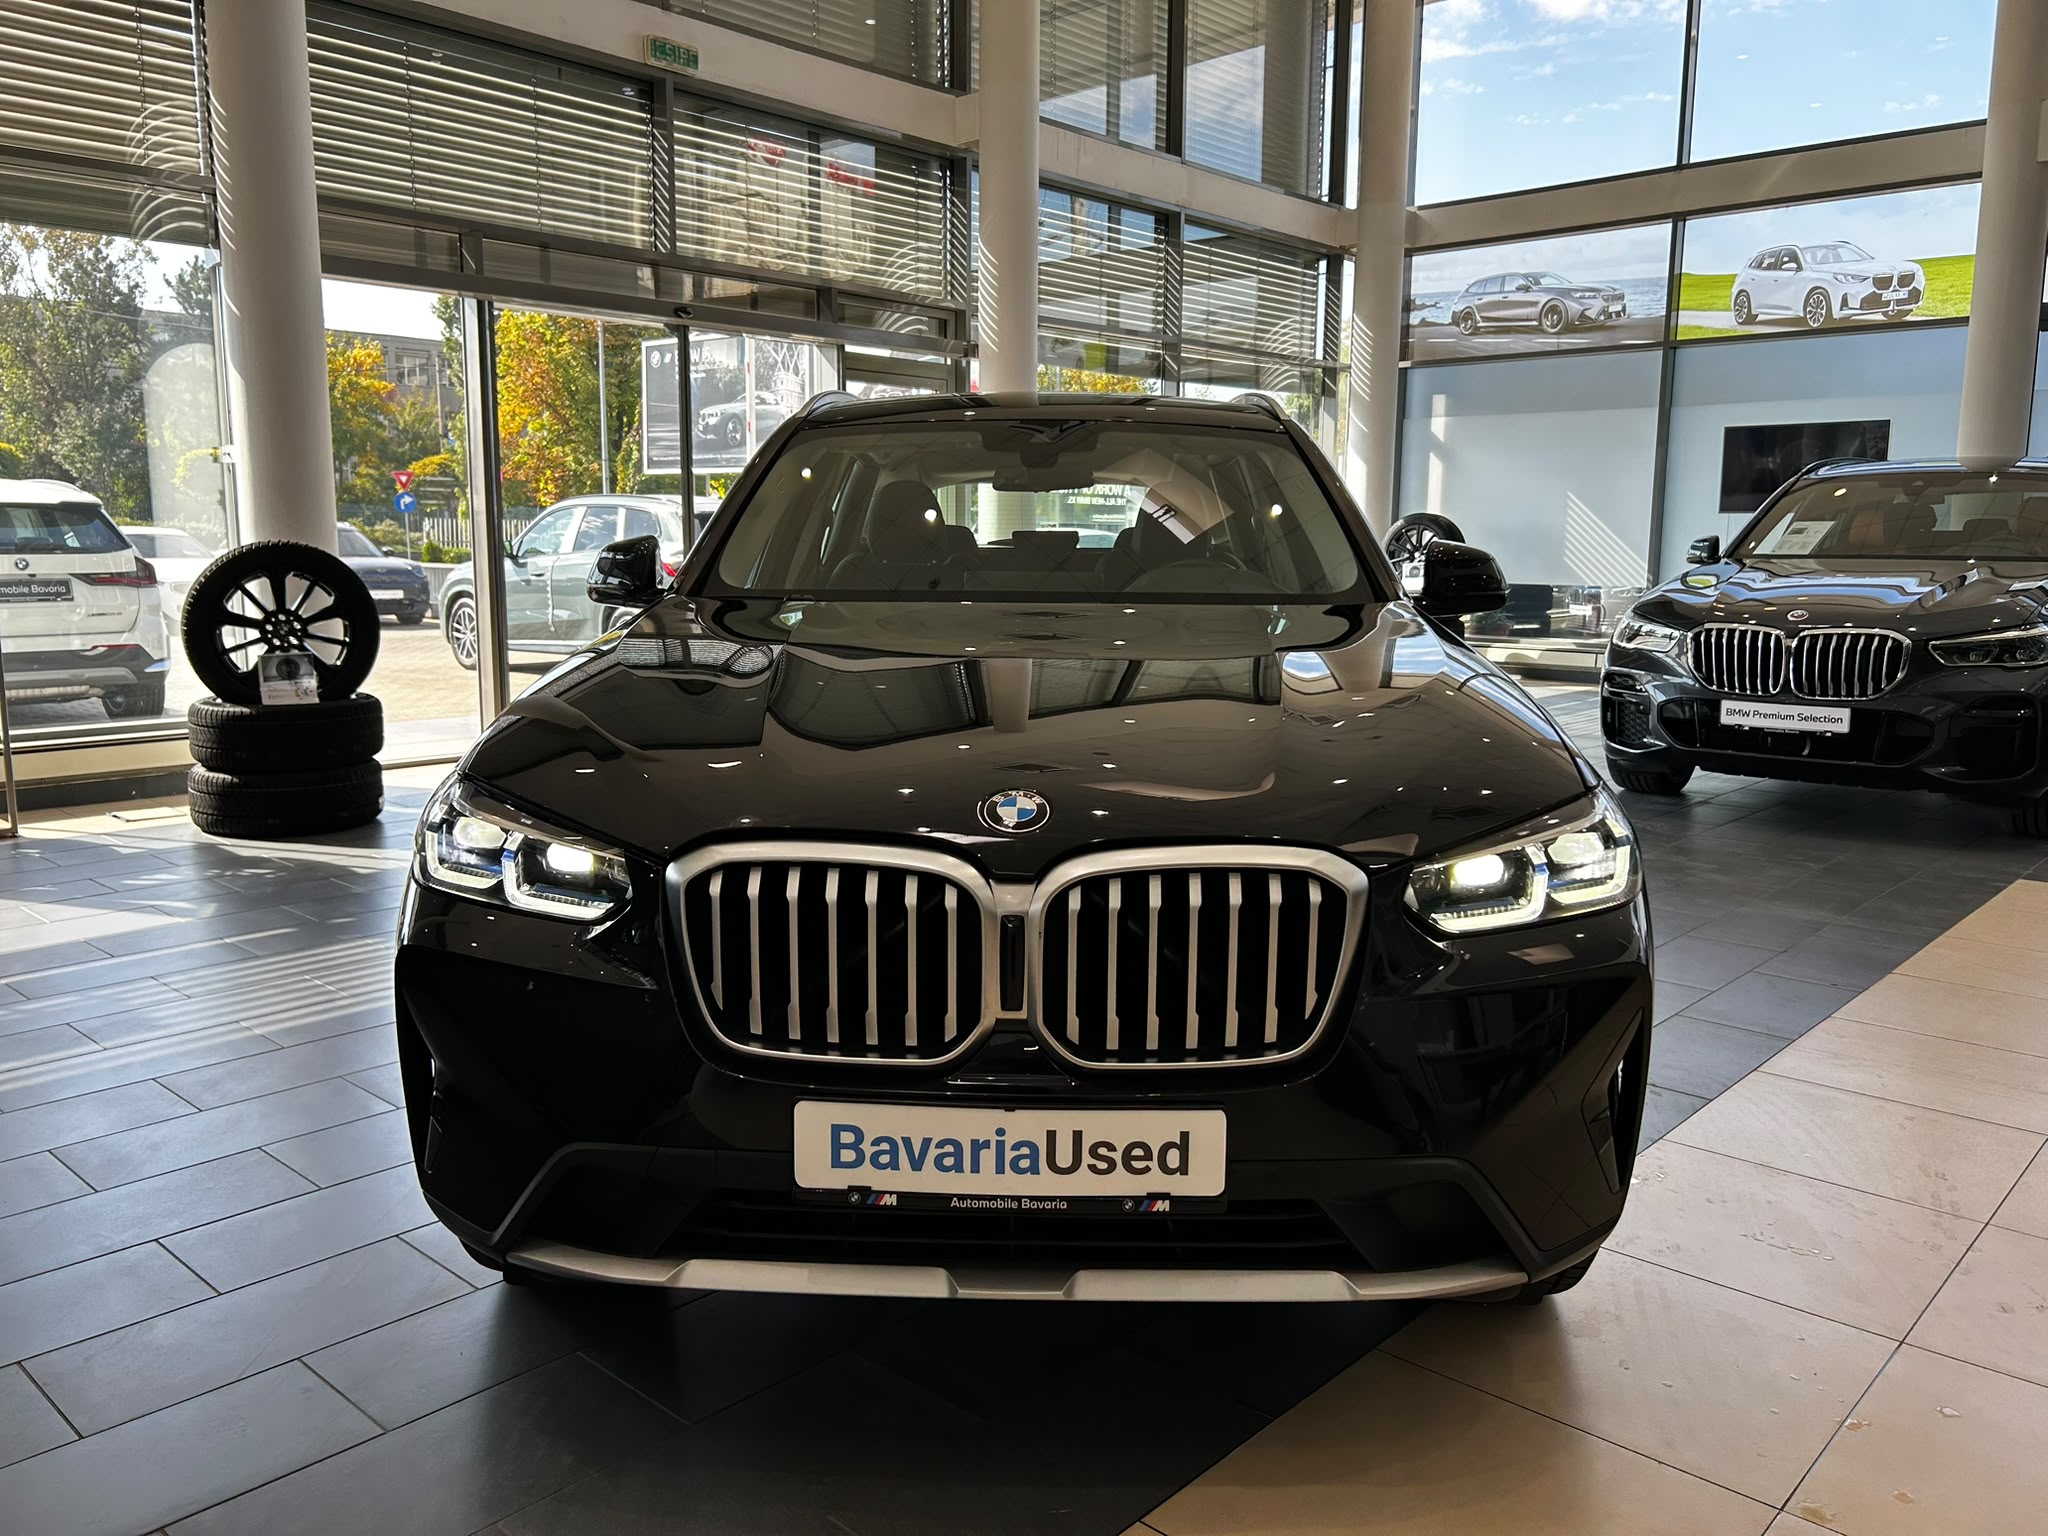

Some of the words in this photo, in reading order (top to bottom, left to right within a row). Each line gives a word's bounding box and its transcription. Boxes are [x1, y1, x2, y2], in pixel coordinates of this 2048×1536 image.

[31, 584, 66, 593] Bavaria
[1725, 707, 1751, 718] BMW
[1752, 710, 1795, 722] Premium
[1797, 712, 1844, 725] Selection
[830, 1123, 1190, 1176] BavariaUsed
[950, 1197, 1018, 1209] Automobile
[1021, 1198, 1067, 1209] Bavaria
